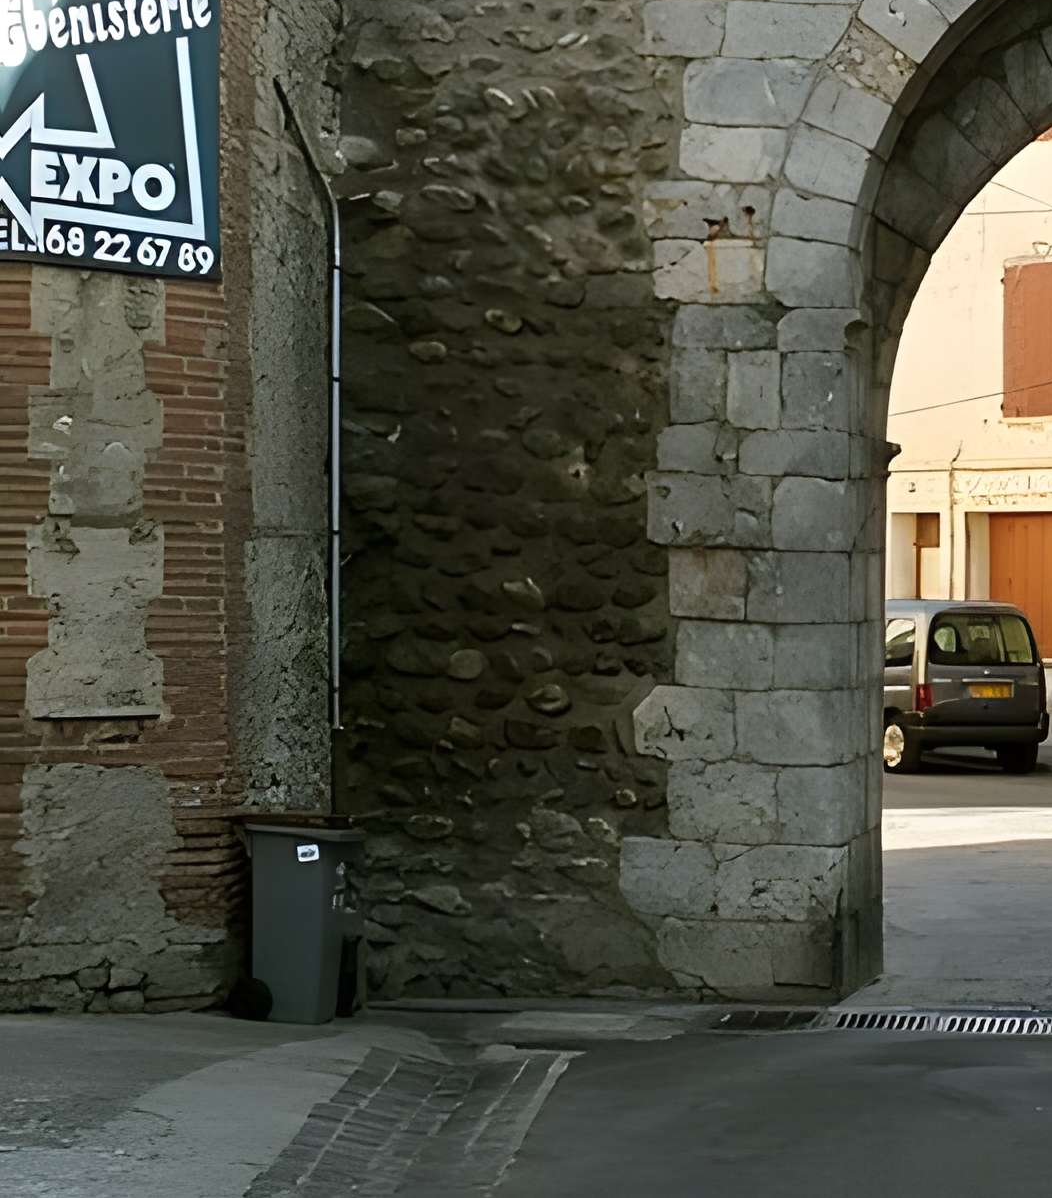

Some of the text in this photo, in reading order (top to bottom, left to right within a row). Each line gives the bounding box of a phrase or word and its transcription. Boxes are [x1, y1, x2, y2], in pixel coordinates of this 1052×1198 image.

[31, 149, 176, 211] EXPO
[46, 224, 85, 257] 68
[93, 230, 132, 263] 22
[137, 236, 172, 267] 67
